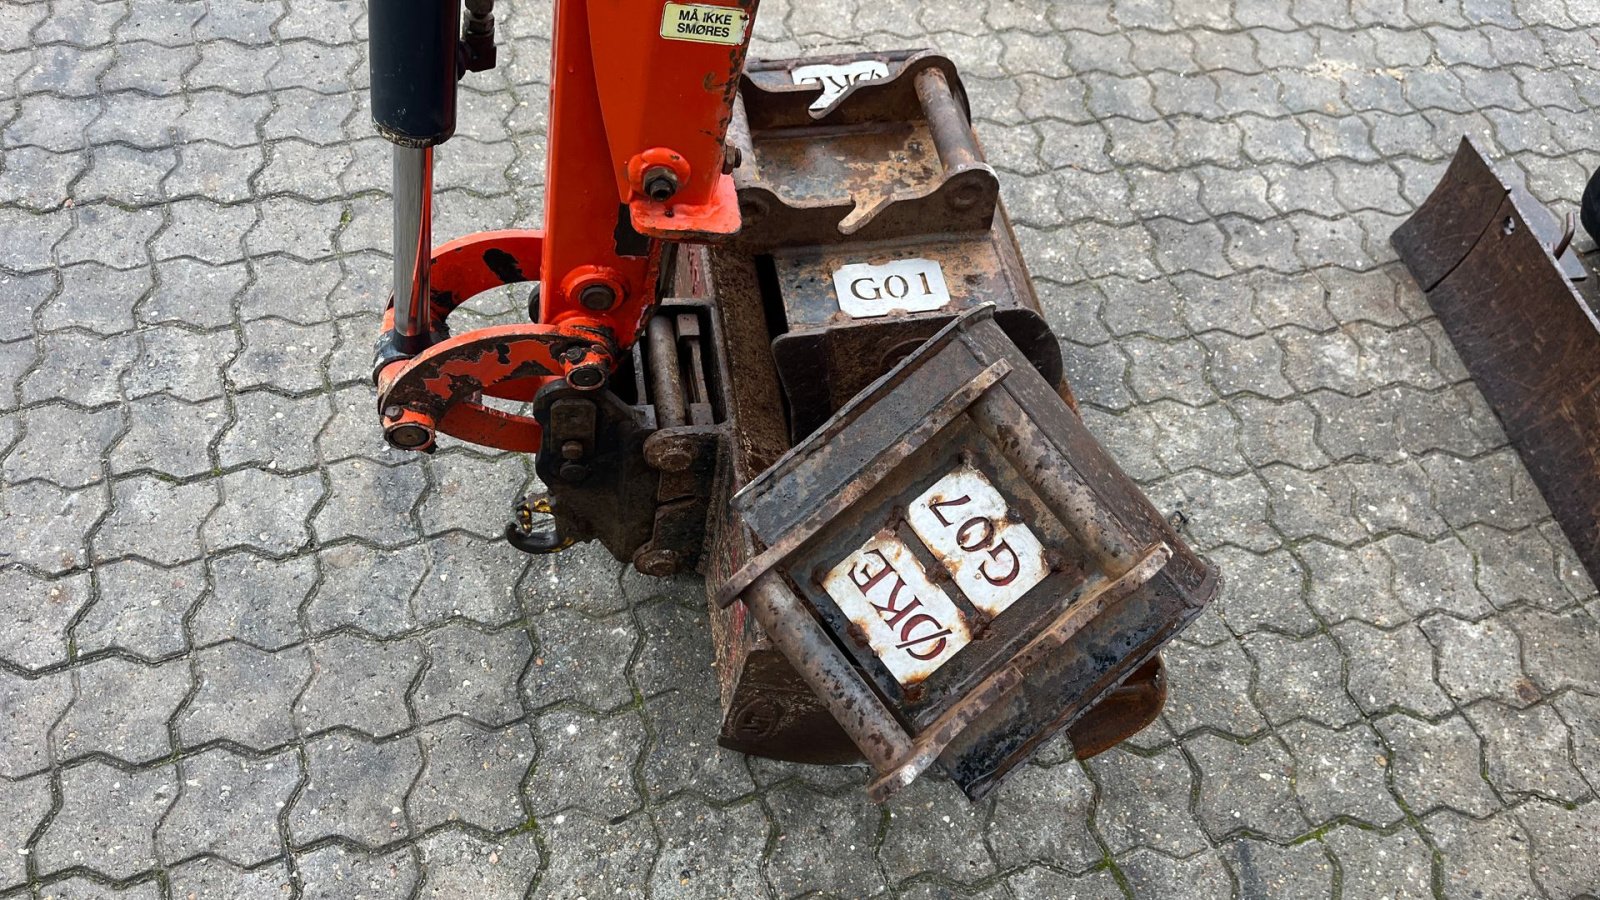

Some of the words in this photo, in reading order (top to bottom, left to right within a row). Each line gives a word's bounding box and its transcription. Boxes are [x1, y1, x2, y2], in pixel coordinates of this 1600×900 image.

[679, 8, 698, 22] MÅ
[702, 12, 732, 25] IKKE
[677, 22, 730, 37] SMØRES
[847, 548, 953, 661] ØKE
